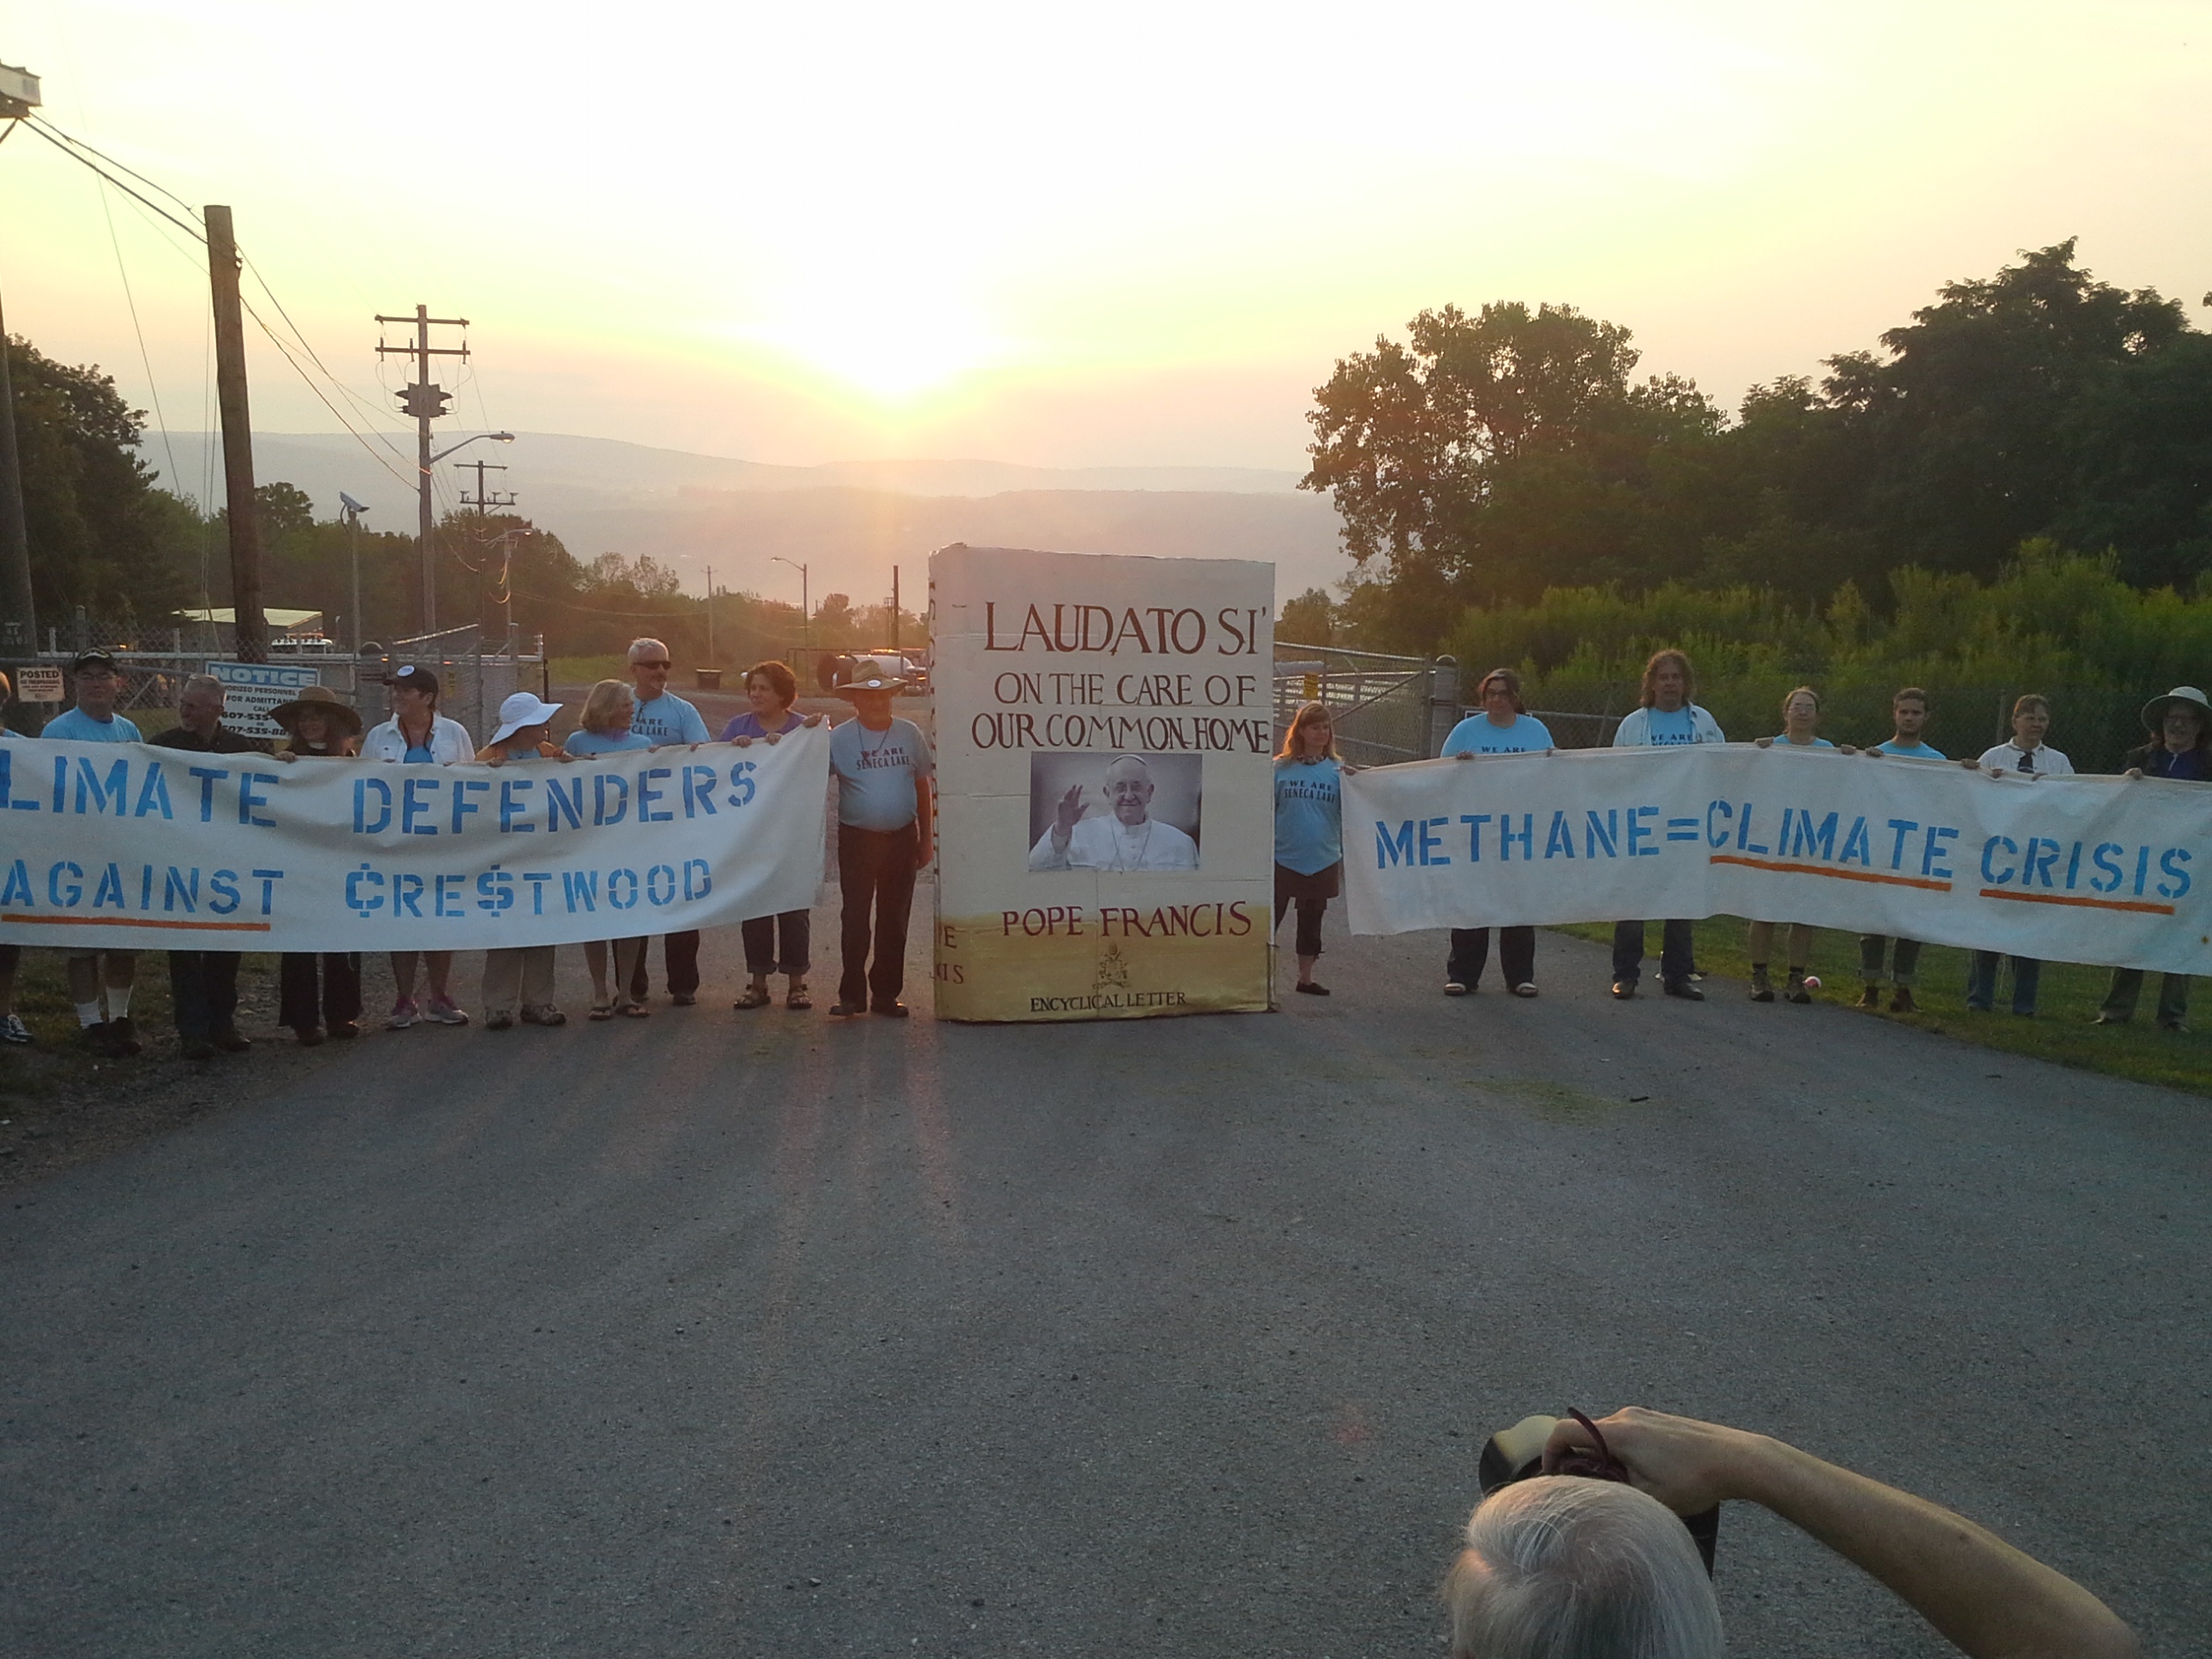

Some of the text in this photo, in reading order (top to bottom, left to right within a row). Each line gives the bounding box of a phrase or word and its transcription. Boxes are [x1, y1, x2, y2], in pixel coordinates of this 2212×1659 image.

[984, 602, 1206, 656] LAUDATO
[210, 666, 317, 687] NOTICE
[254, 687, 296, 696] PERSONNEL
[995, 672, 1256, 707] ON THE CARE OF
[646, 727, 668, 736] LAKE
[971, 713, 1044, 748] OUR
[883, 747, 904, 756] ARE
[856, 755, 910, 771] SENECA LAKE
[1284, 787, 1313, 799] SENECA
[1311, 781, 1332, 791] ARE
[353, 760, 758, 835] DEFENDERS
[1980, 836, 2192, 899] CRISIS
[0, 860, 284, 916] AGAINST
[1002, 900, 1251, 938] POPE FRANCIS
[1030, 992, 1187, 1013] ENCYCLICAL LETTER
